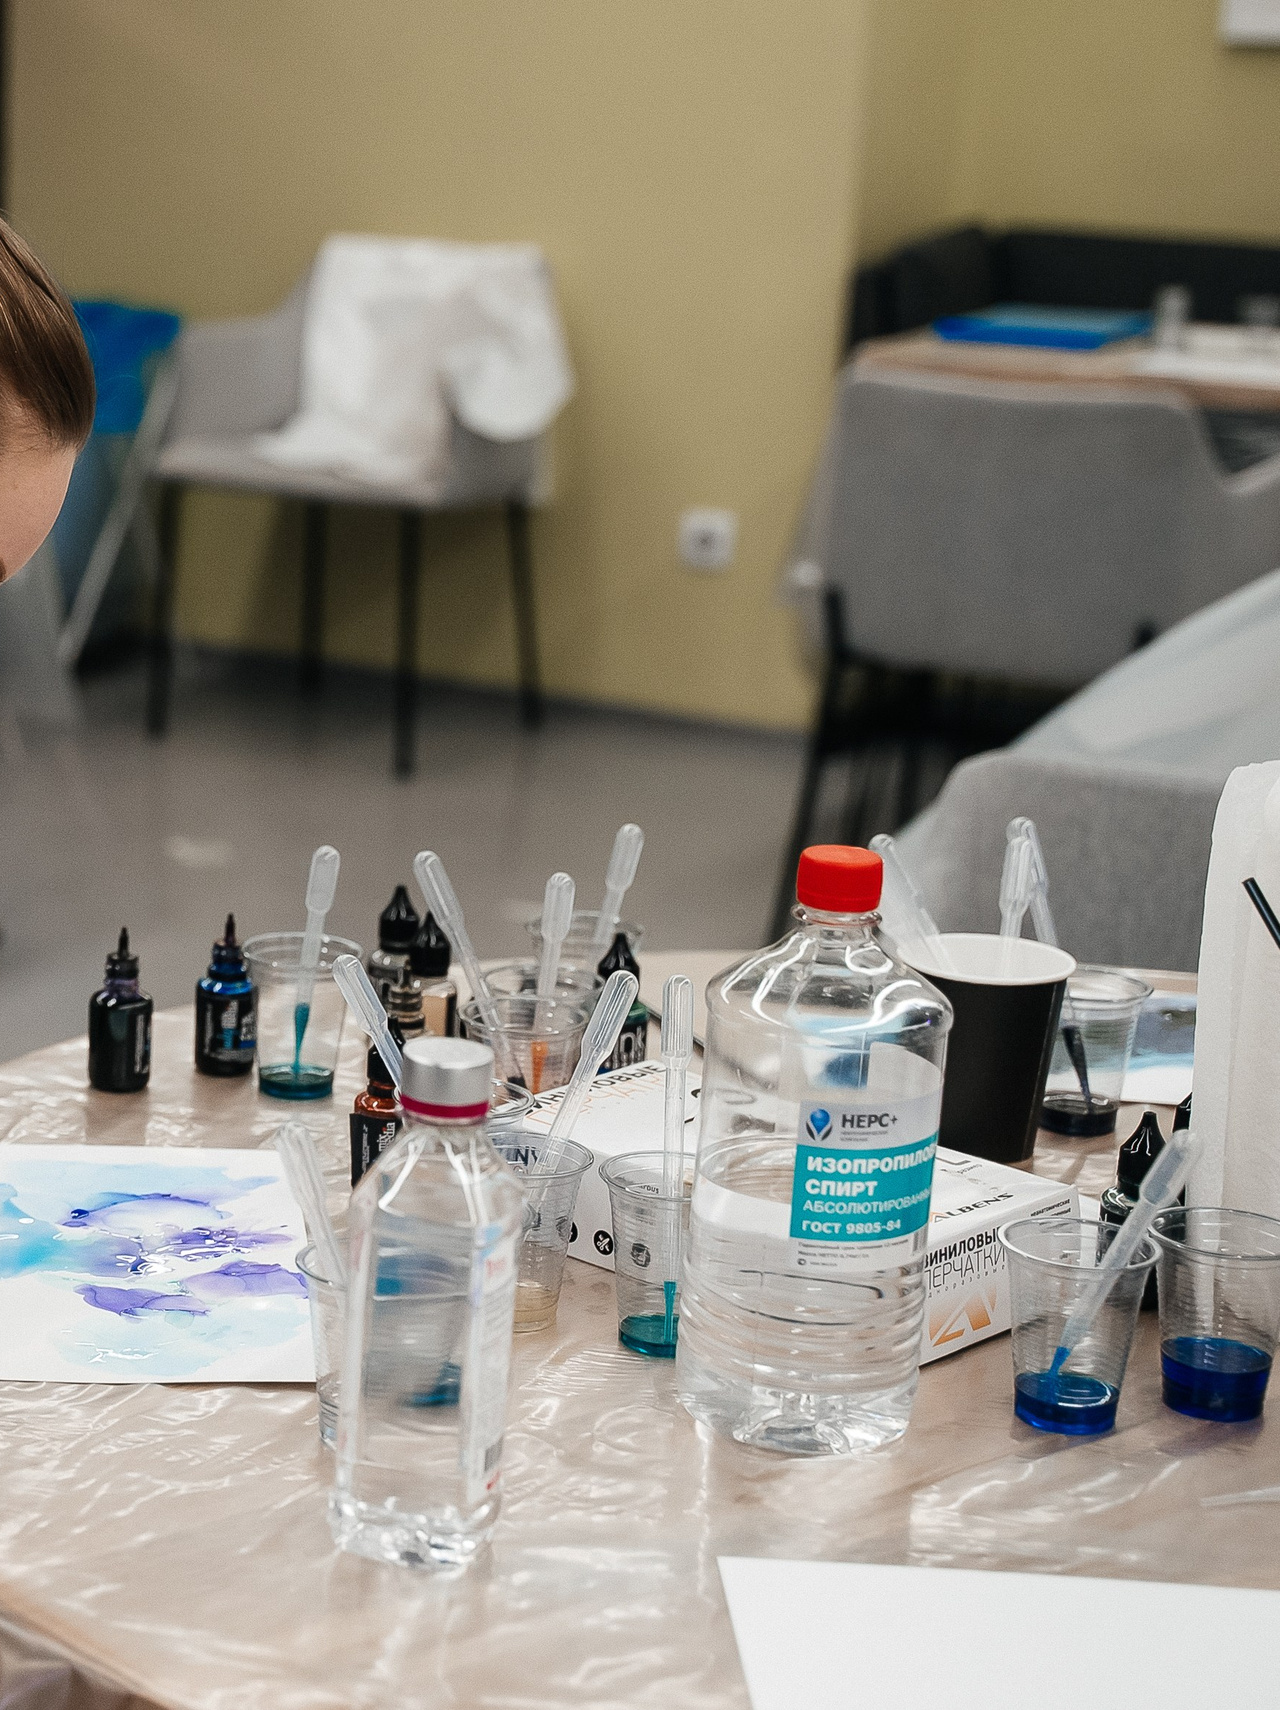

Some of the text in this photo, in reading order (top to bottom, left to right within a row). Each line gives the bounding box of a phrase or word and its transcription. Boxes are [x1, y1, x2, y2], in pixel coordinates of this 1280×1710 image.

[841, 1113, 898, 1129] НЕРС+
[805, 1178, 878, 1197] СПИРТ
[803, 1188, 931, 1215] АБСОЛЮТИРОВАН
[801, 1219, 902, 1235] ГОСТ 9805-84
[924, 1226, 1000, 1269] ИНИЛОВЫ
[928, 1264, 1006, 1298] дноразовые
